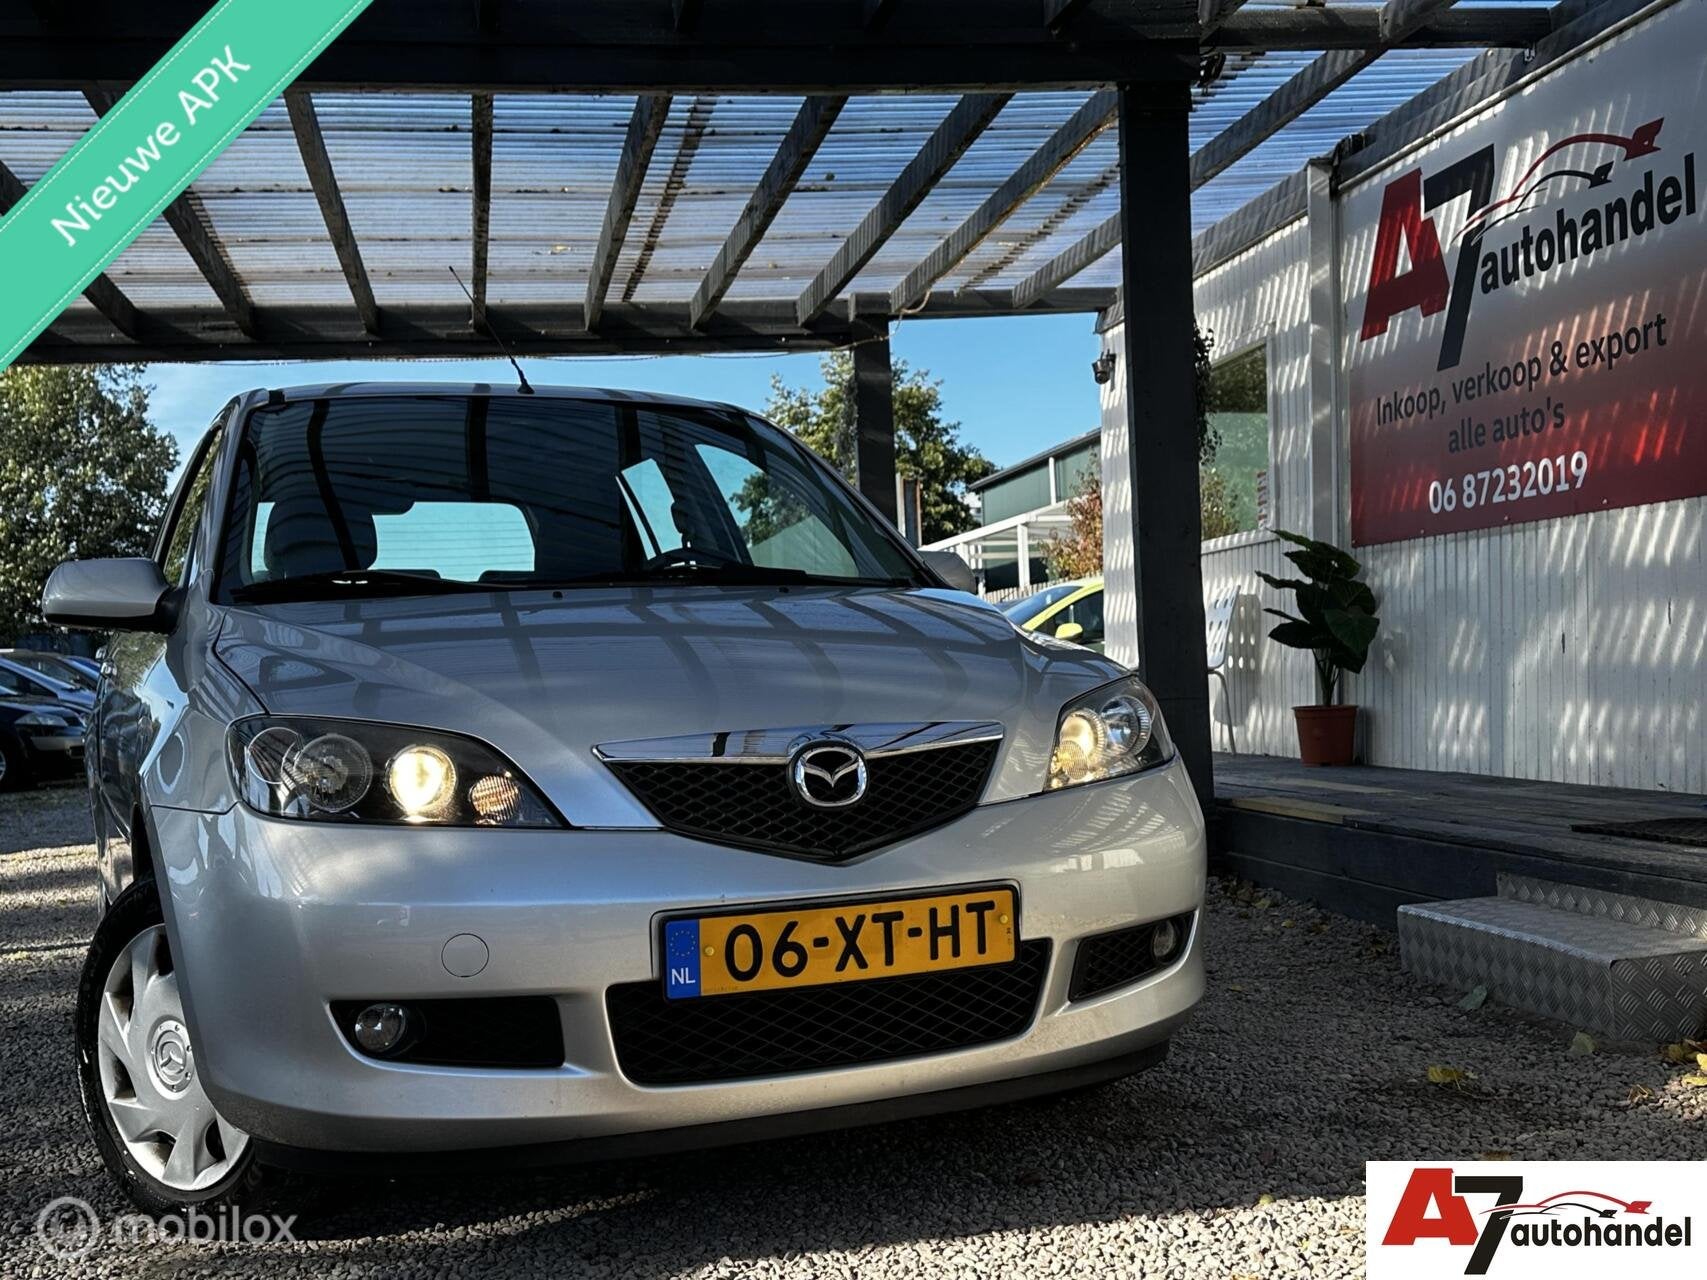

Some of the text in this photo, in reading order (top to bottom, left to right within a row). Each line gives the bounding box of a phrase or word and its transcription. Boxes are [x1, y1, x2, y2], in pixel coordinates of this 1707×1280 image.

[1480, 152, 1697, 294] autohandel
[1376, 313, 1667, 427] Inkoop, verkoop & export
[1447, 397, 1566, 455] alle auto's
[1428, 450, 1588, 515] 06 87232019
[671, 968, 696, 985] NL
[724, 900, 996, 982] 06-XT-HT
